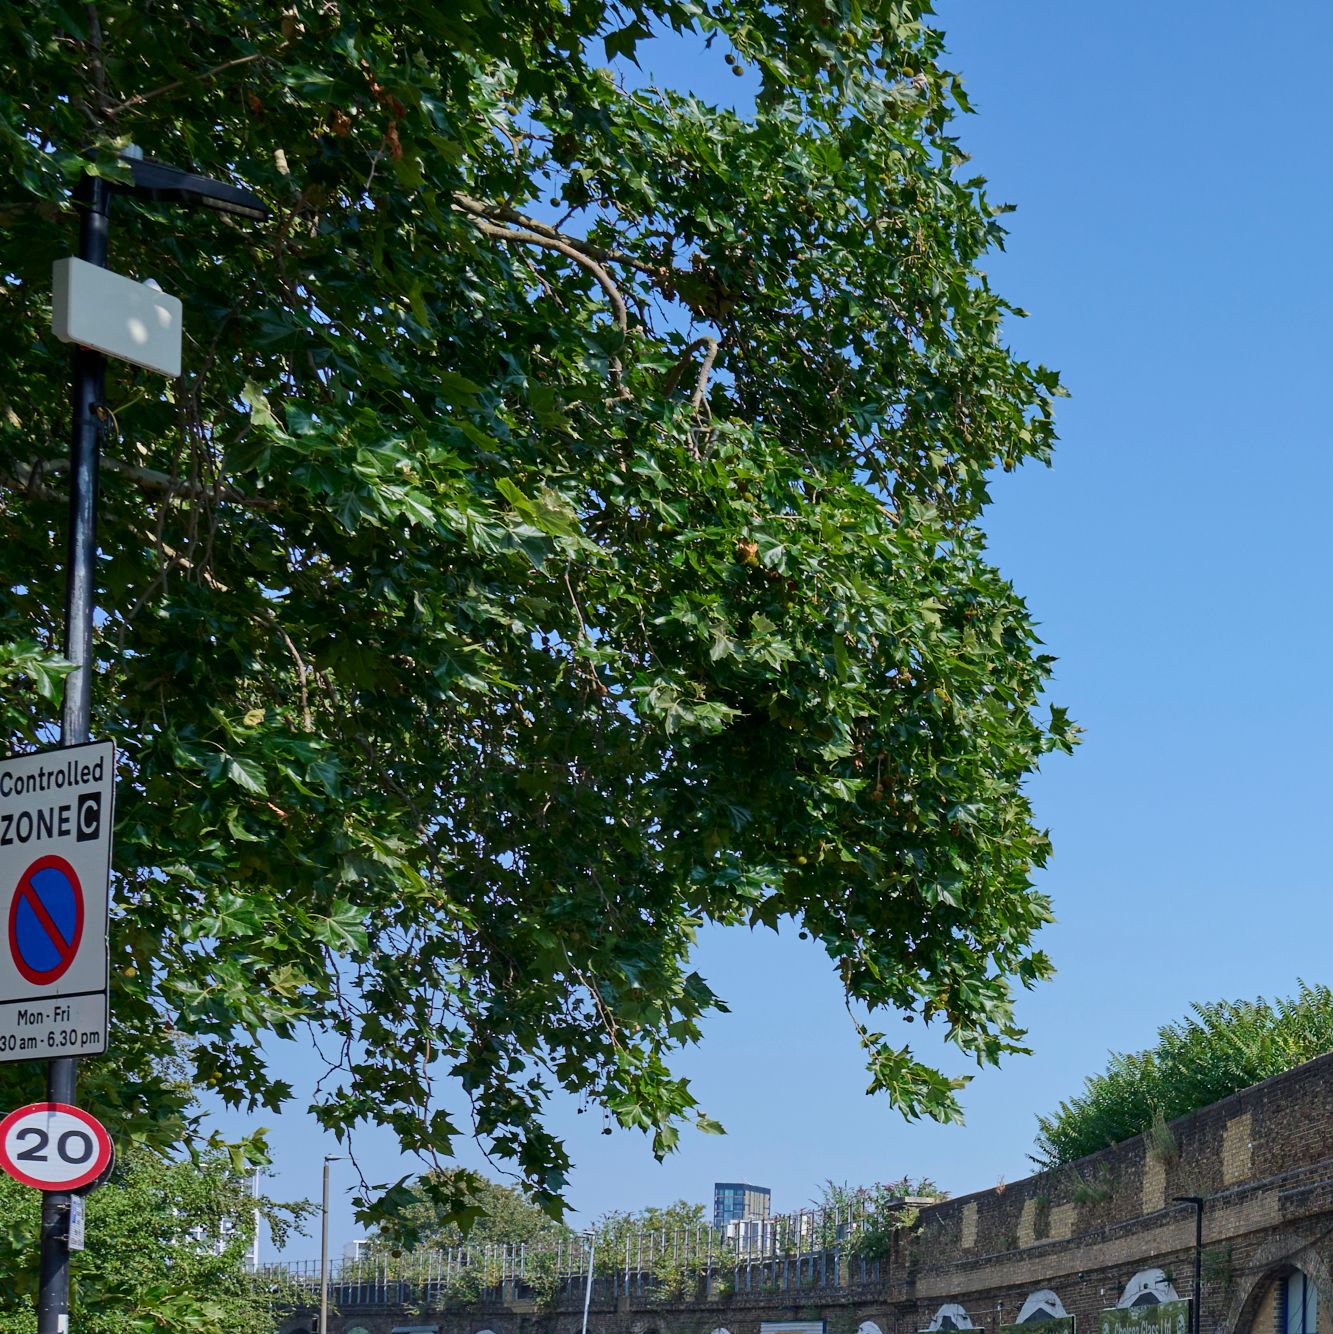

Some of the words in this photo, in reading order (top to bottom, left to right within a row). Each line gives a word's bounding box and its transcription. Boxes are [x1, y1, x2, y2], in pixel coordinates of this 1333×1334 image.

[1, 756, 104, 797] Controlled
[1, 804, 71, 846] ZONE
[80, 799, 99, 834] C
[17, 1009, 44, 1026] Mon
[53, 1005, 70, 1023] Fri
[19, 1036, 38, 1050] am
[47, 1029, 77, 1049] 6.30
[80, 1029, 100, 1048] pm
[16, 1127, 94, 1164] 20
